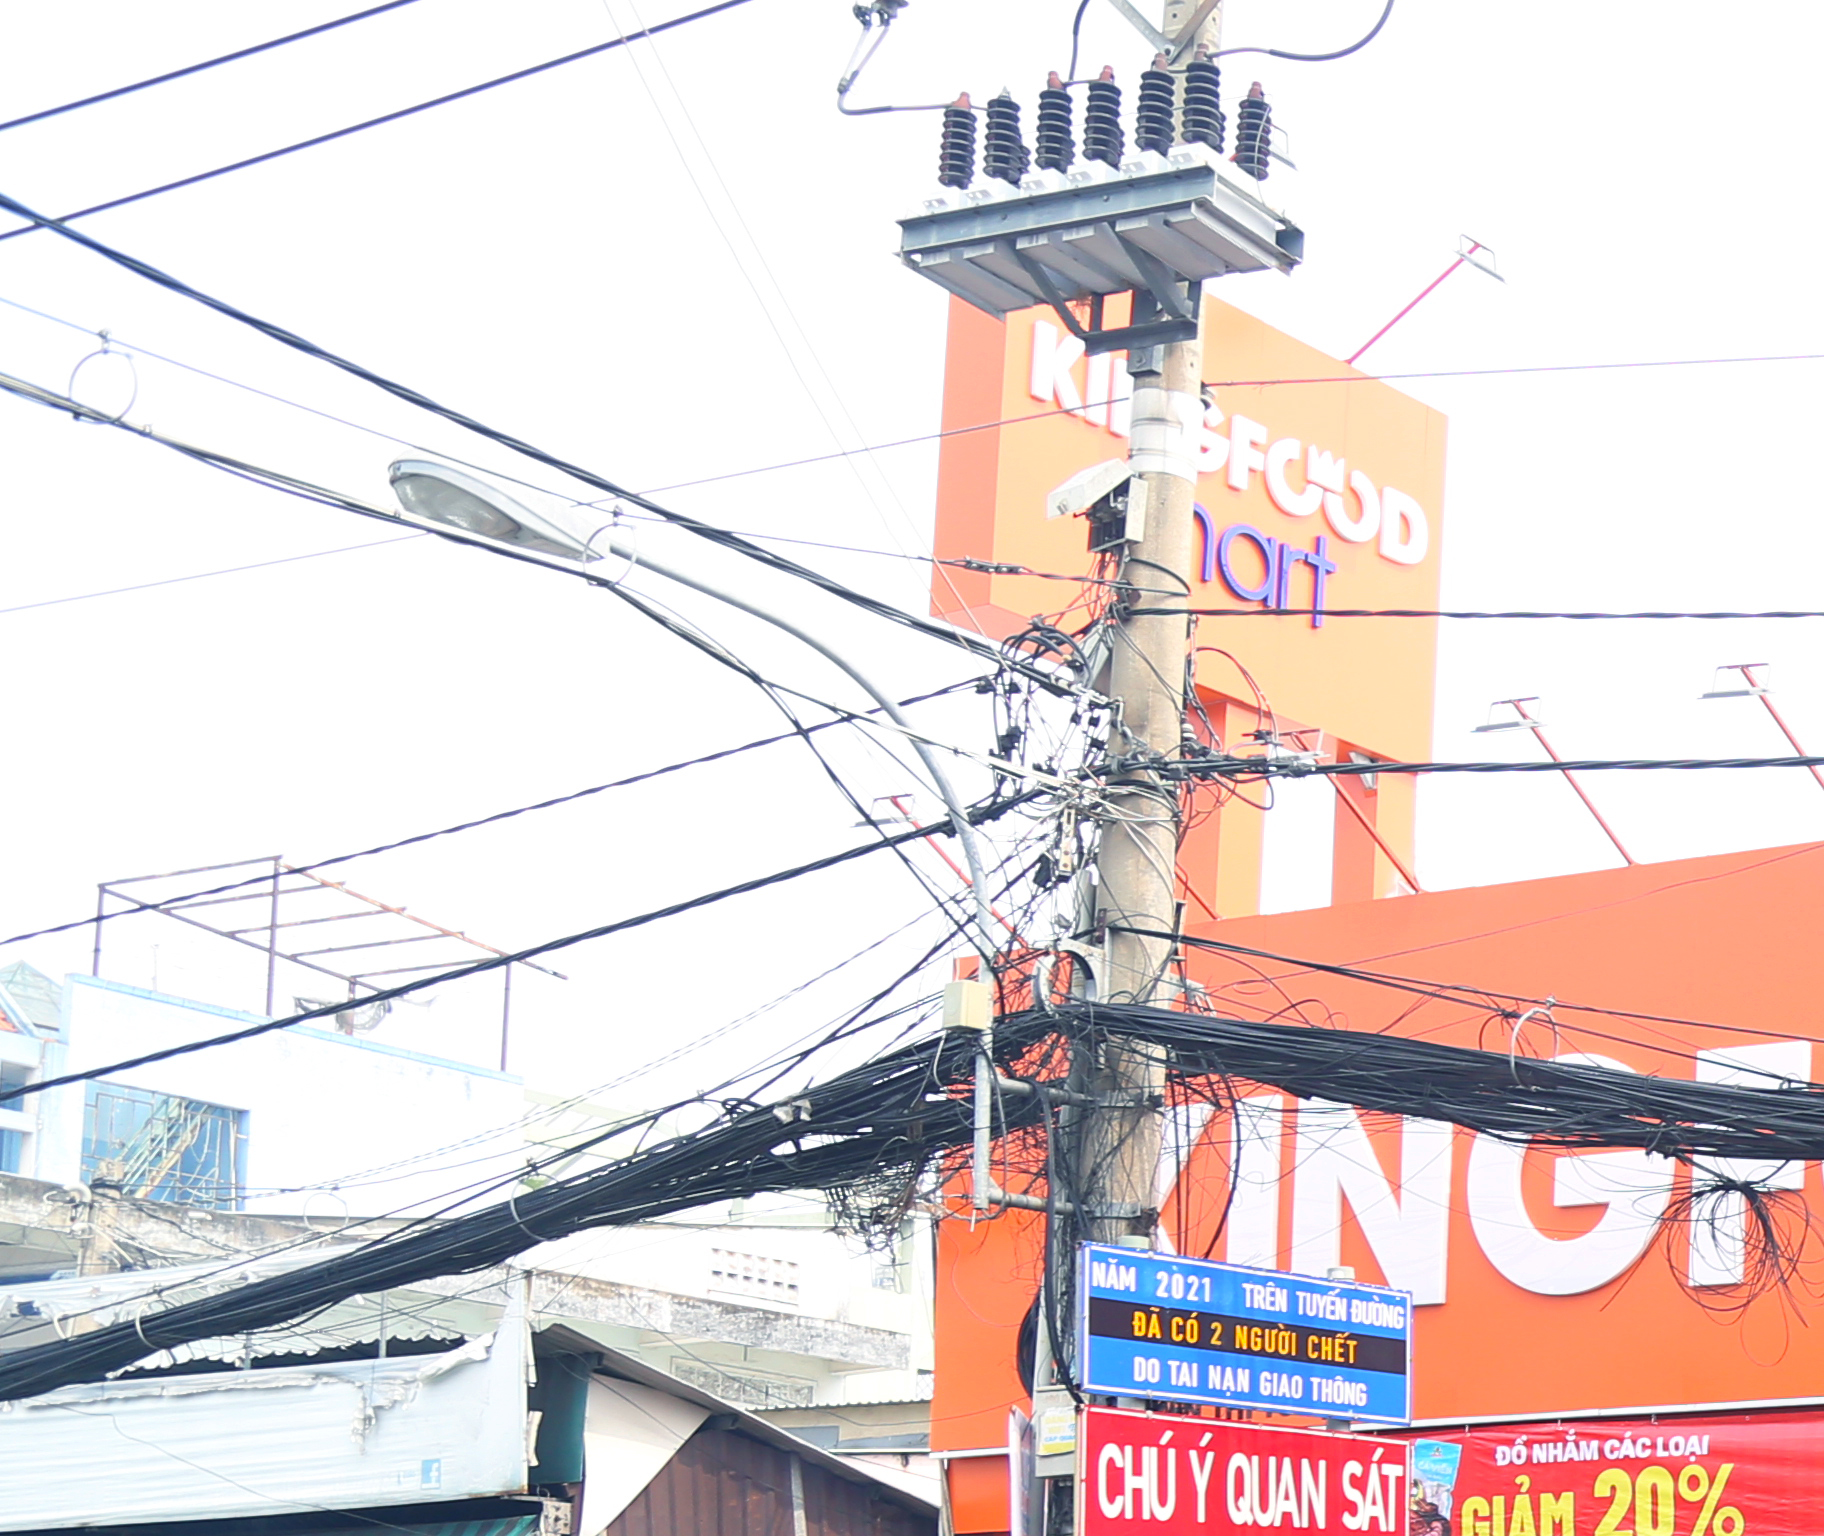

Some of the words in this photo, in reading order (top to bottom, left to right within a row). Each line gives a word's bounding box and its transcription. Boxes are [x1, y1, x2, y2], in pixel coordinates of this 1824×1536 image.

[1091, 1259, 1136, 1293] NĂM
[1155, 1271, 1212, 1303] 2021
[1243, 1281, 1287, 1314] TRÊN
[1296, 1287, 1347, 1322] TUYẾN
[1350, 1295, 1404, 1330] ĐƯỜNG
[1132, 1307, 1161, 1339] ĐÃ
[1171, 1314, 1199, 1344] CÓ
[1210, 1322, 1223, 1346] 2
[1234, 1321, 1298, 1357] NGƯỜI
[1307, 1331, 1358, 1365] CHẾT
[1134, 1357, 1160, 1384] DO
[1167, 1360, 1198, 1388] TAI
[1208, 1363, 1250, 1397] NẠN
[1259, 1369, 1303, 1400] GIAO
[1310, 1374, 1367, 1408] THÔNG
[1603, 1432, 1652, 1460] CÁC
[1655, 1435, 1710, 1463] LOẠI
[1098, 1430, 1178, 1522] CHÚ
[1188, 1432, 1214, 1524] Ý
[1226, 1452, 1326, 1531] QUAN
[1341, 1447, 1405, 1534] SÁT
